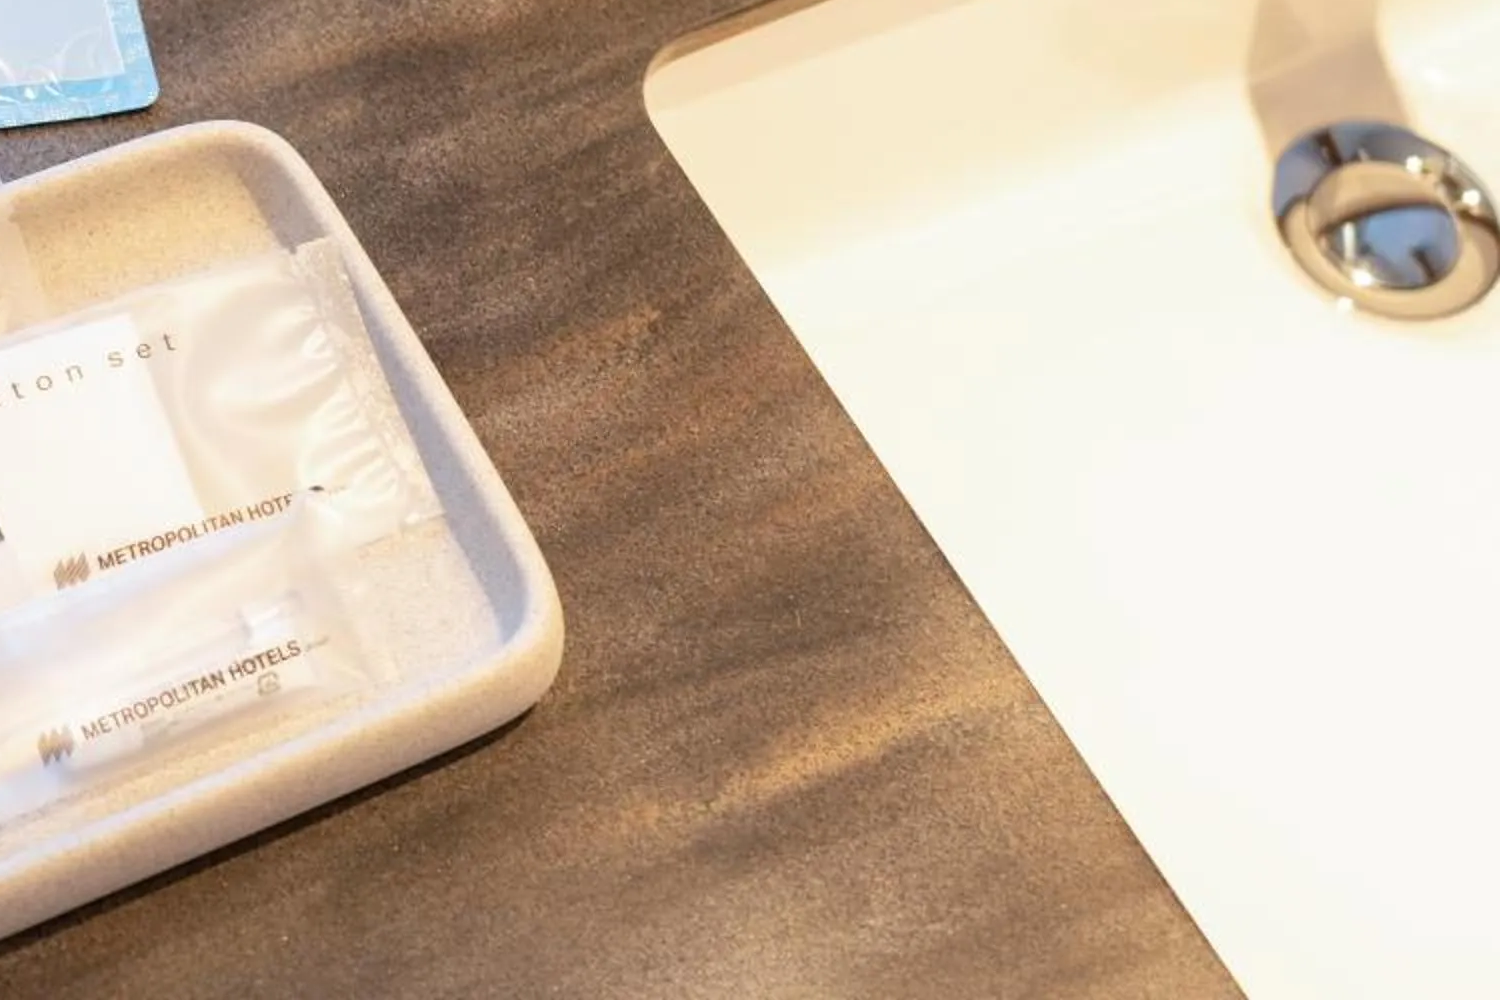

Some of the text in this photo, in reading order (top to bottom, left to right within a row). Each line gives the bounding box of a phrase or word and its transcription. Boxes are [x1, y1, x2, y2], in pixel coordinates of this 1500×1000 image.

[107, 333, 177, 368] set
[97, 507, 244, 571] METROPOLITAN
[80, 669, 227, 742] METROPOLITAN
[228, 639, 302, 682] HOTELS
